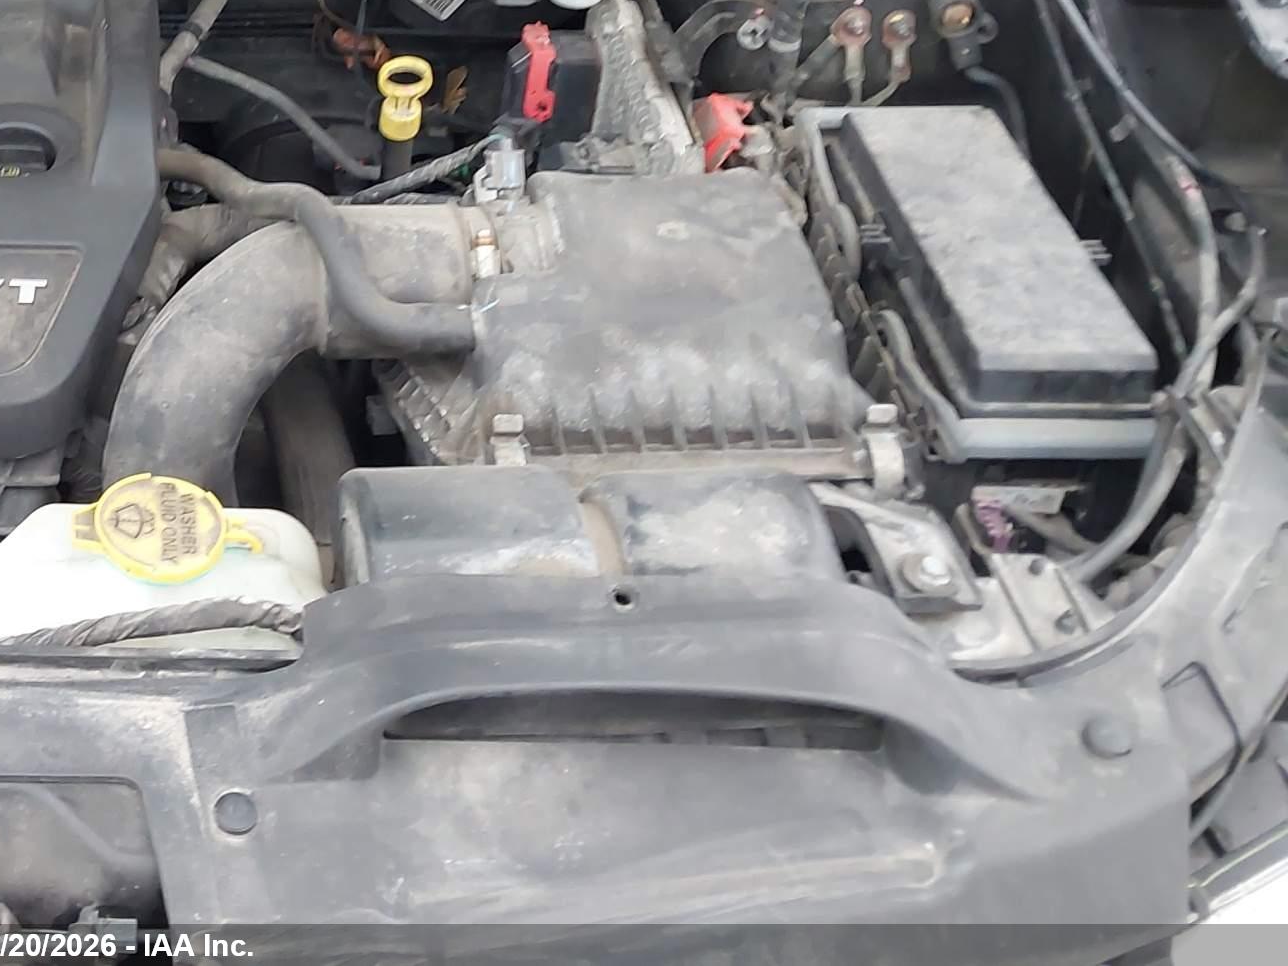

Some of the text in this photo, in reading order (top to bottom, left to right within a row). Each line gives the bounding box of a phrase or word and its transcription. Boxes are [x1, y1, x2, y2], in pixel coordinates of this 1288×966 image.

[160, 482, 178, 564] FLUID ONLY
[180, 493, 198, 555] WASHER
